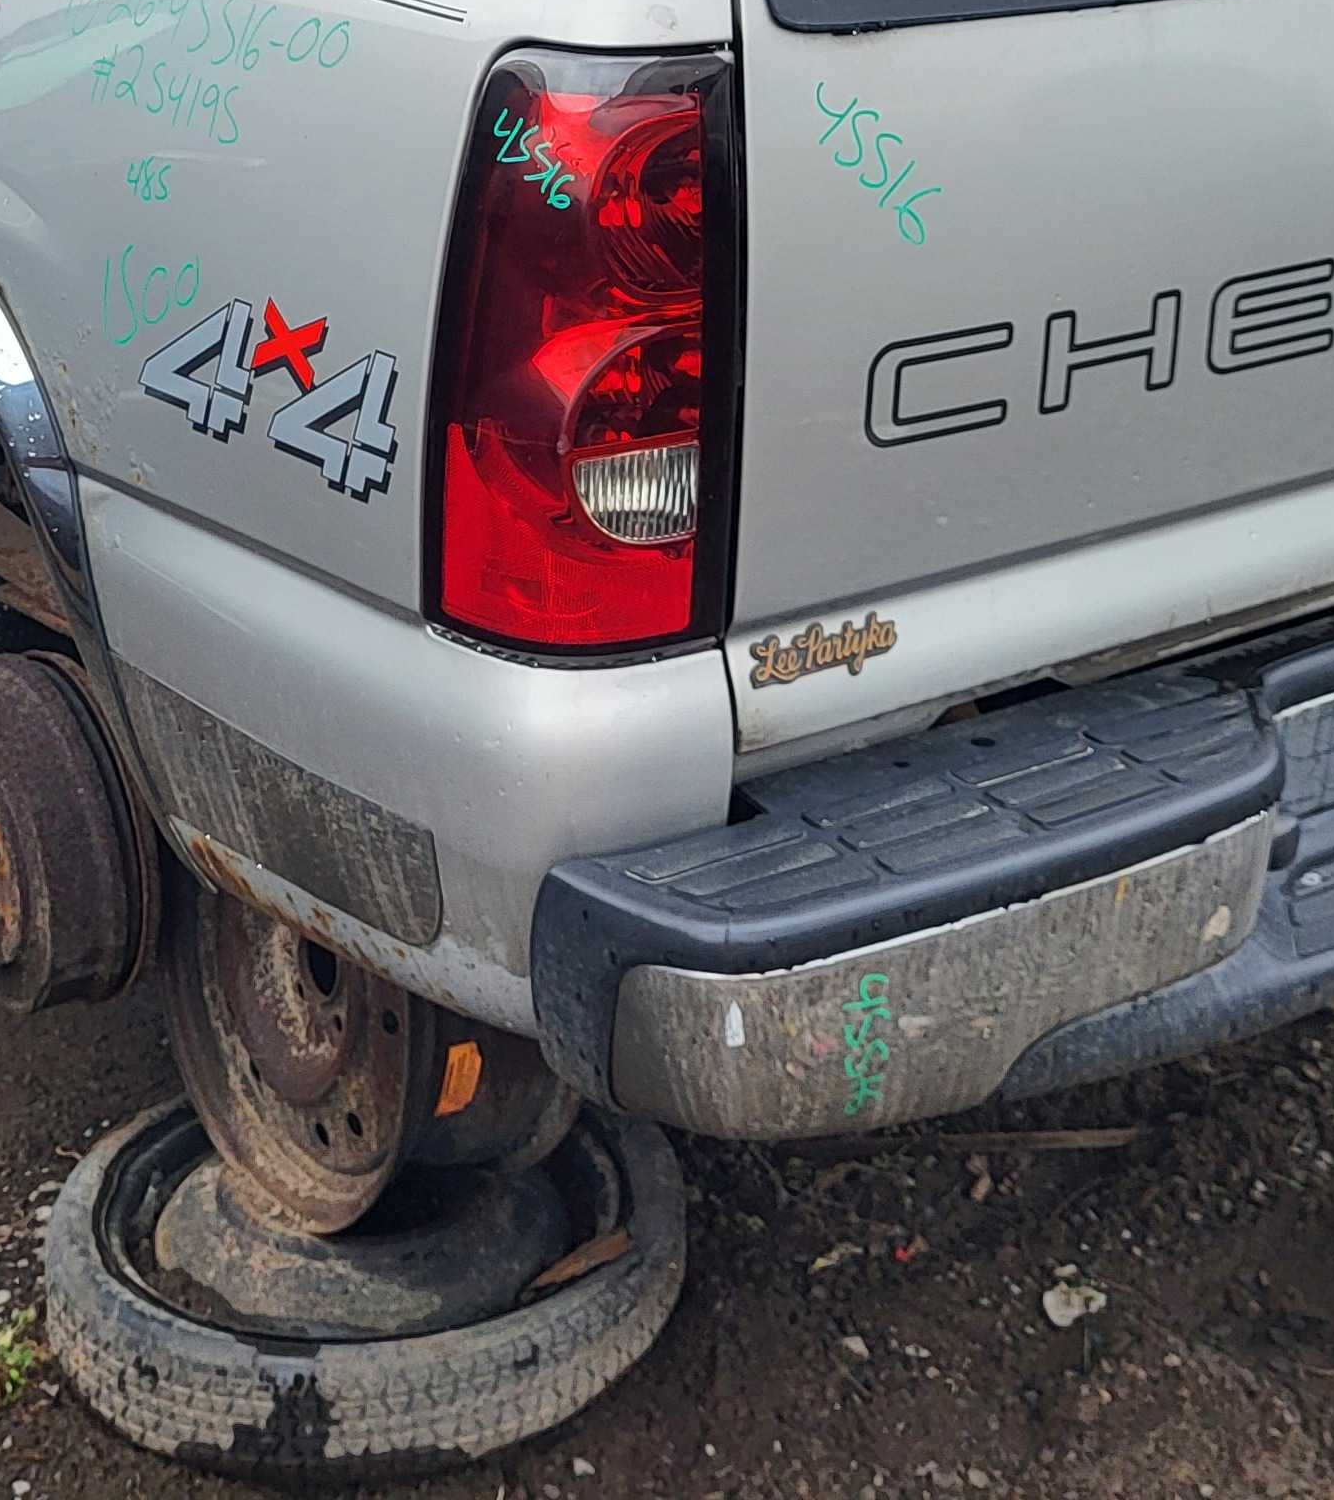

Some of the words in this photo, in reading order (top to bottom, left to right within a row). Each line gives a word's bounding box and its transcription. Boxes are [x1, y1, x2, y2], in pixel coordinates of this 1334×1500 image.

[493, 107, 576, 210] 45516
[102, 243, 201, 346] 1500
[753, 636, 802, 684] Lee
[796, 612, 896, 674] Partyka
